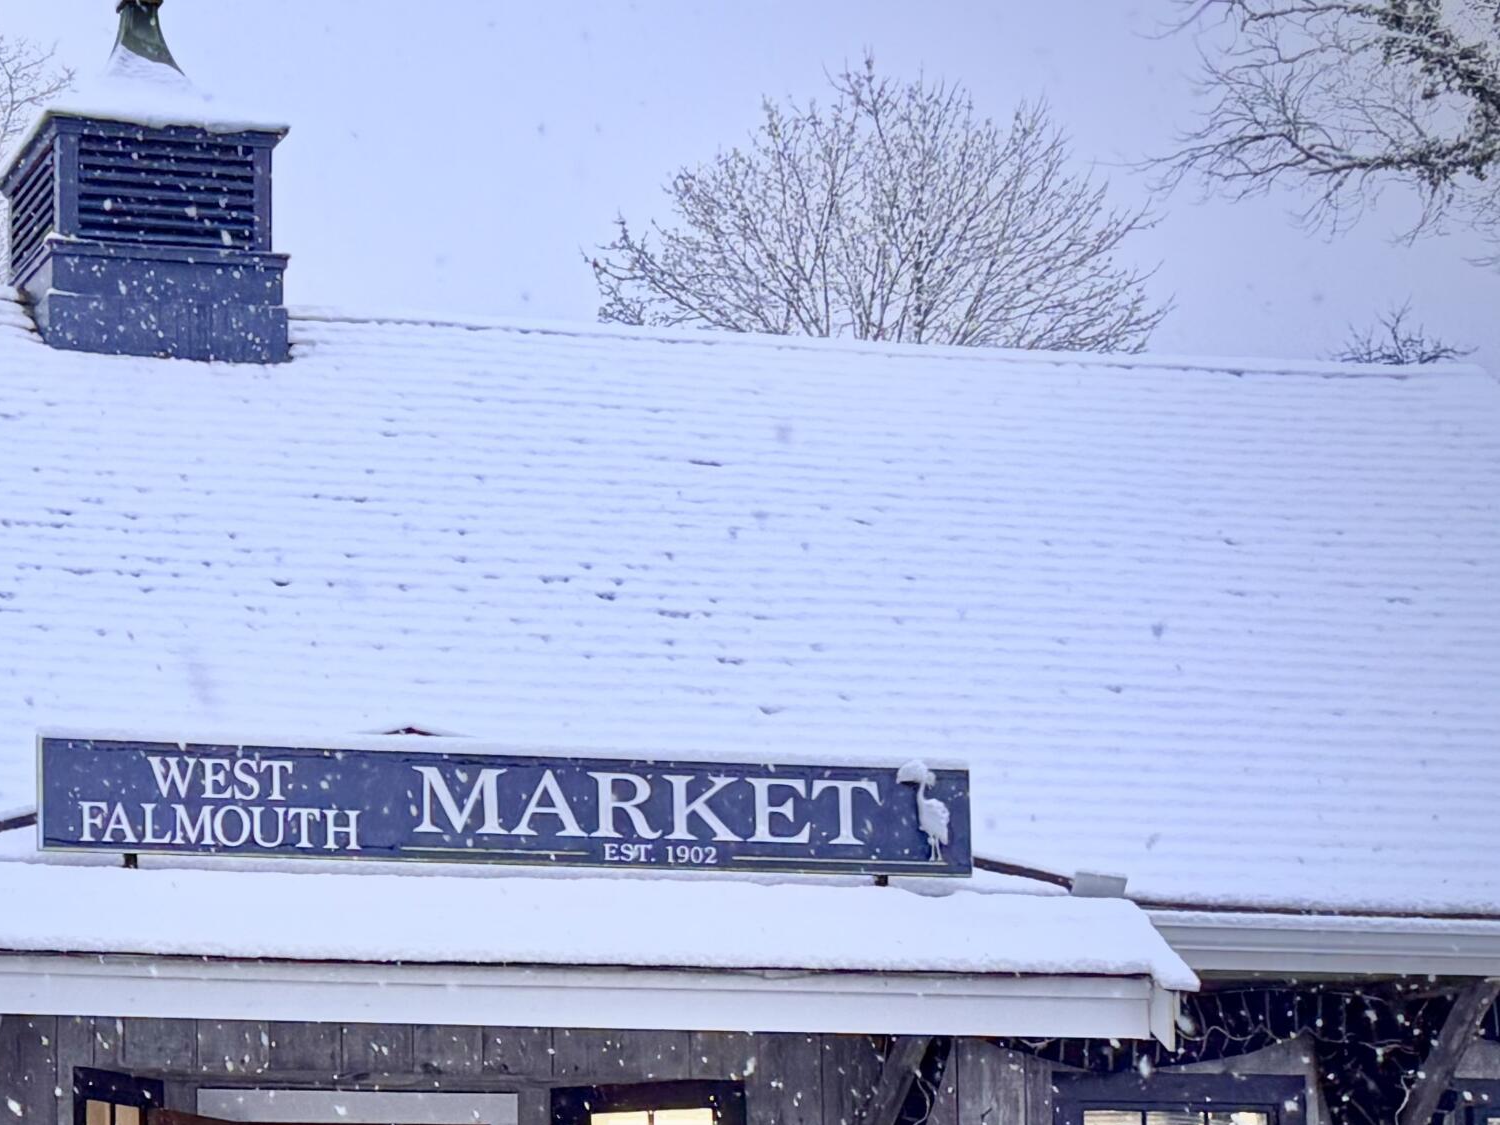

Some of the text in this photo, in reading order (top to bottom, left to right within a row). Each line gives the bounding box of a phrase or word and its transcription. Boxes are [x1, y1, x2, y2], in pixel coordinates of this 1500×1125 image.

[147, 756, 293, 801] WEST
[78, 801, 362, 850] FALMOUTH
[411, 765, 883, 846] MARKET
[603, 843, 718, 864] EST. 1902
